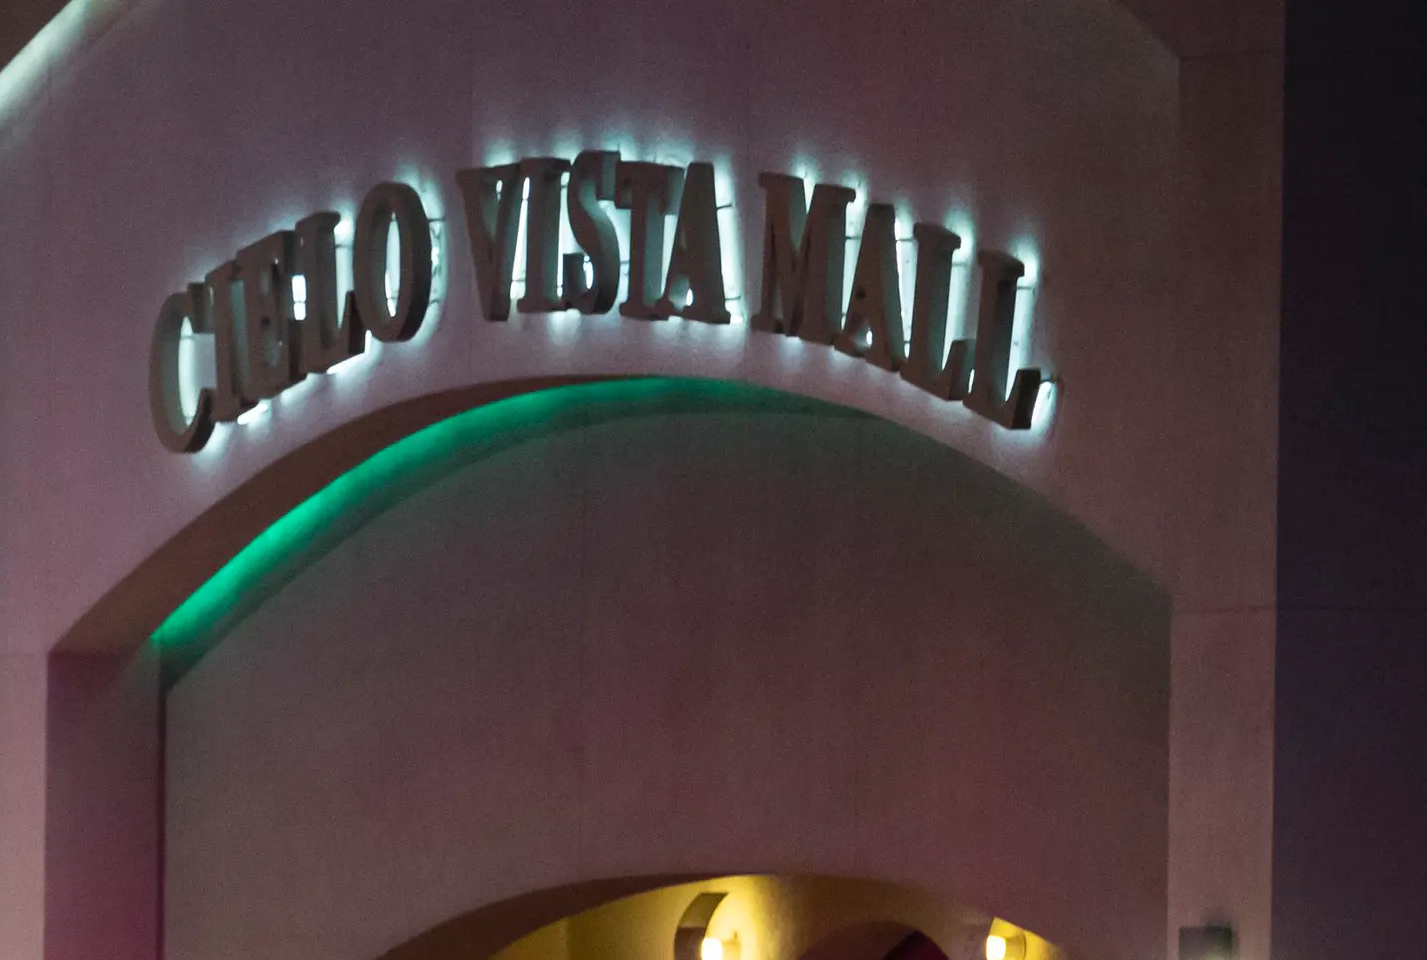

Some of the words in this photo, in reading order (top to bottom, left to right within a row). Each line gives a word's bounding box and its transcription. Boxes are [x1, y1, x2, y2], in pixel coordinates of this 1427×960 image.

[149, 181, 434, 453] CIELO
[456, 151, 739, 325] VISTA
[751, 171, 1052, 430] MALL
